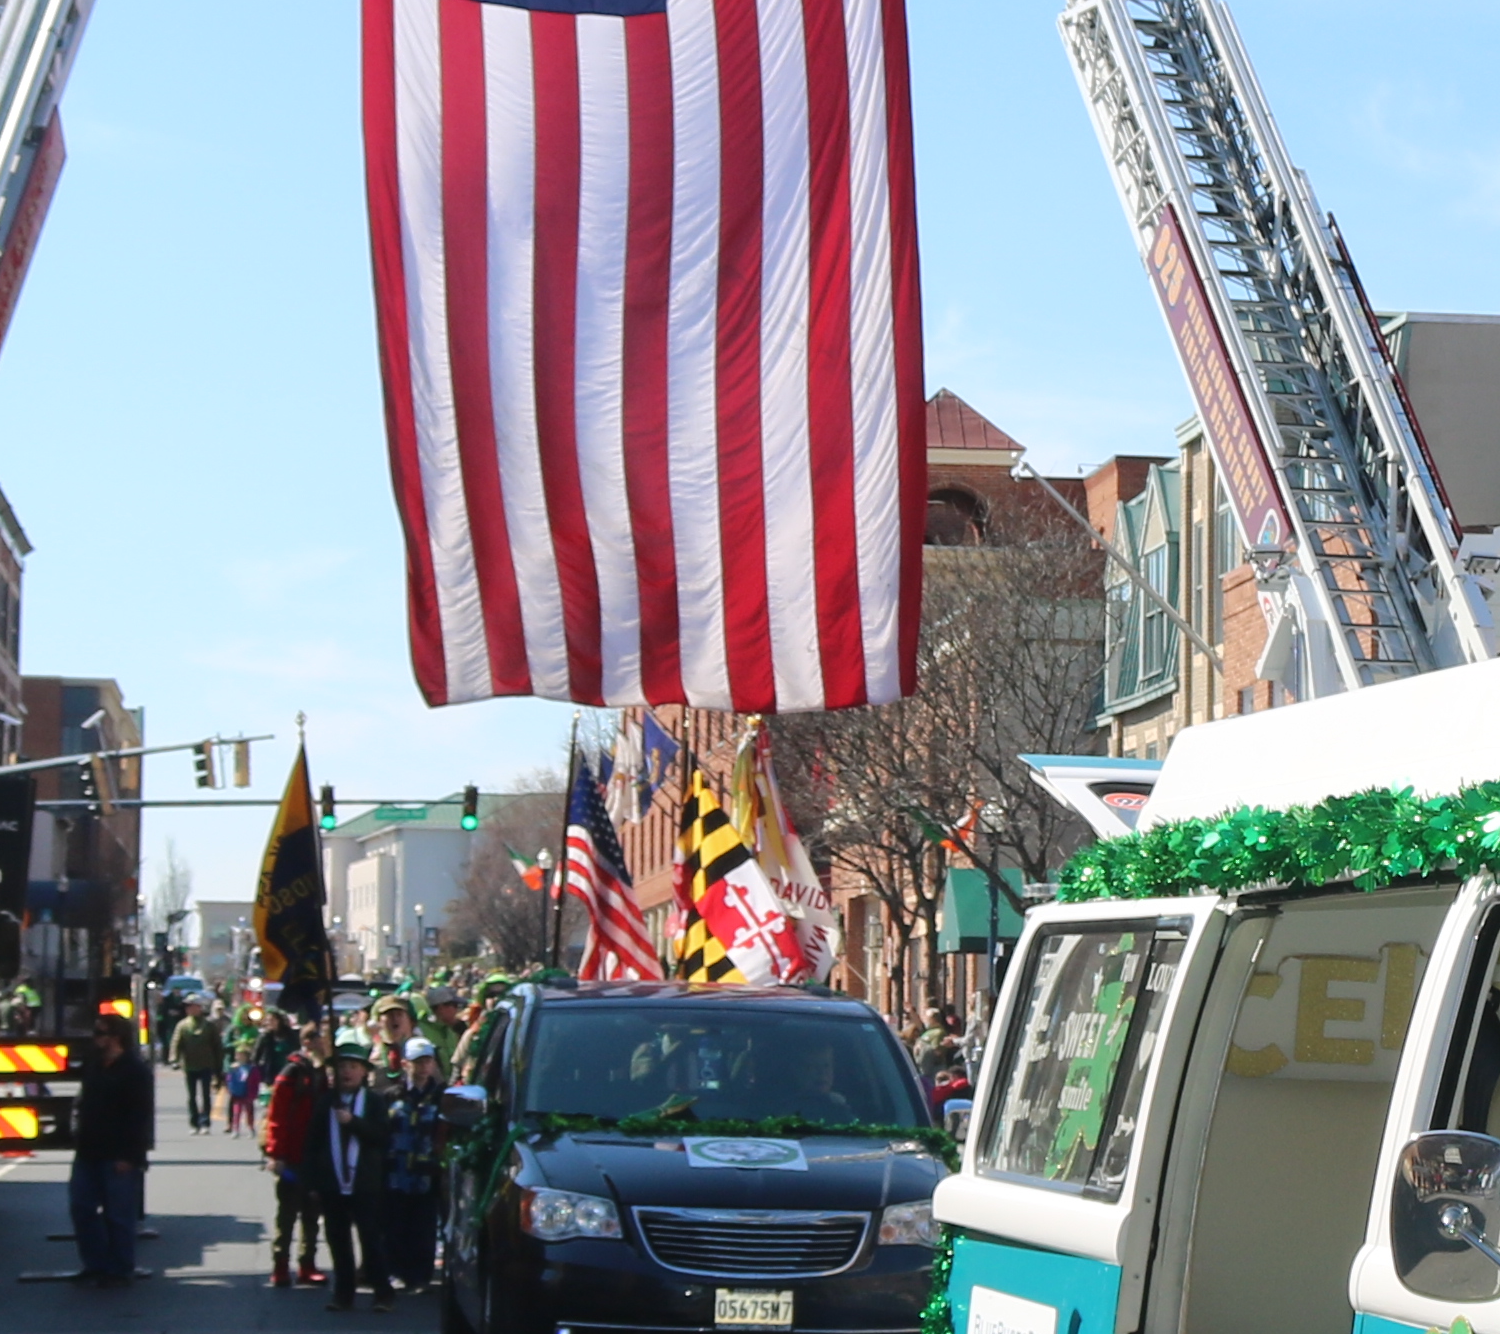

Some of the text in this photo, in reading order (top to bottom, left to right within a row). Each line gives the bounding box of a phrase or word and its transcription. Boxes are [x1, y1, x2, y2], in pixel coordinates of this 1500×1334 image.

[1184, 286, 1211, 356] PRINCE
[1238, 432, 1269, 507] COUNTY
[1209, 401, 1256, 519] DEPARTMENT
[1057, 1011, 1108, 1062] SWEET
[1057, 1075, 1093, 1113] smile
[718, 1299, 792, 1321] 05675M7
